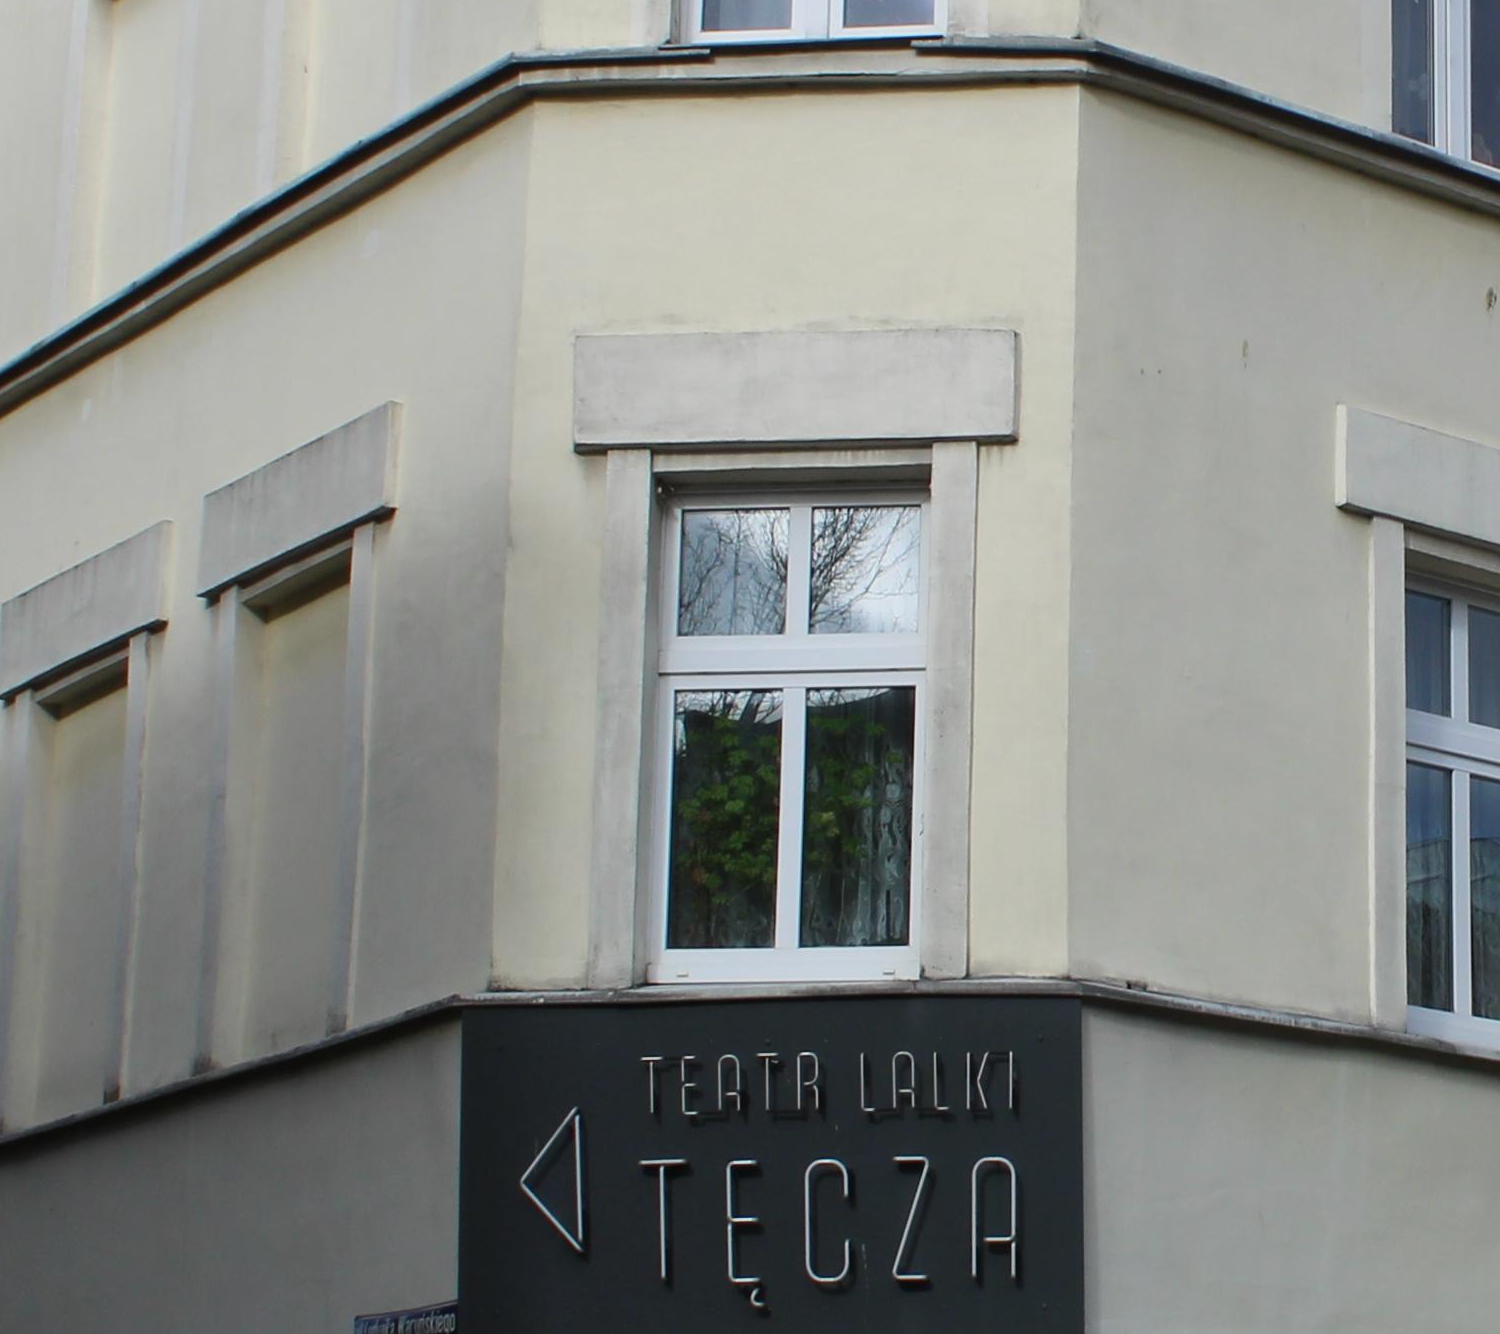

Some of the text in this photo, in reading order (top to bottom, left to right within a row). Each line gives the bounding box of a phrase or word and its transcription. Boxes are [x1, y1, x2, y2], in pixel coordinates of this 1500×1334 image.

[640, 1050, 1014, 1114] TEATR LALKI
[638, 1156, 1018, 1308] TĘCZA
